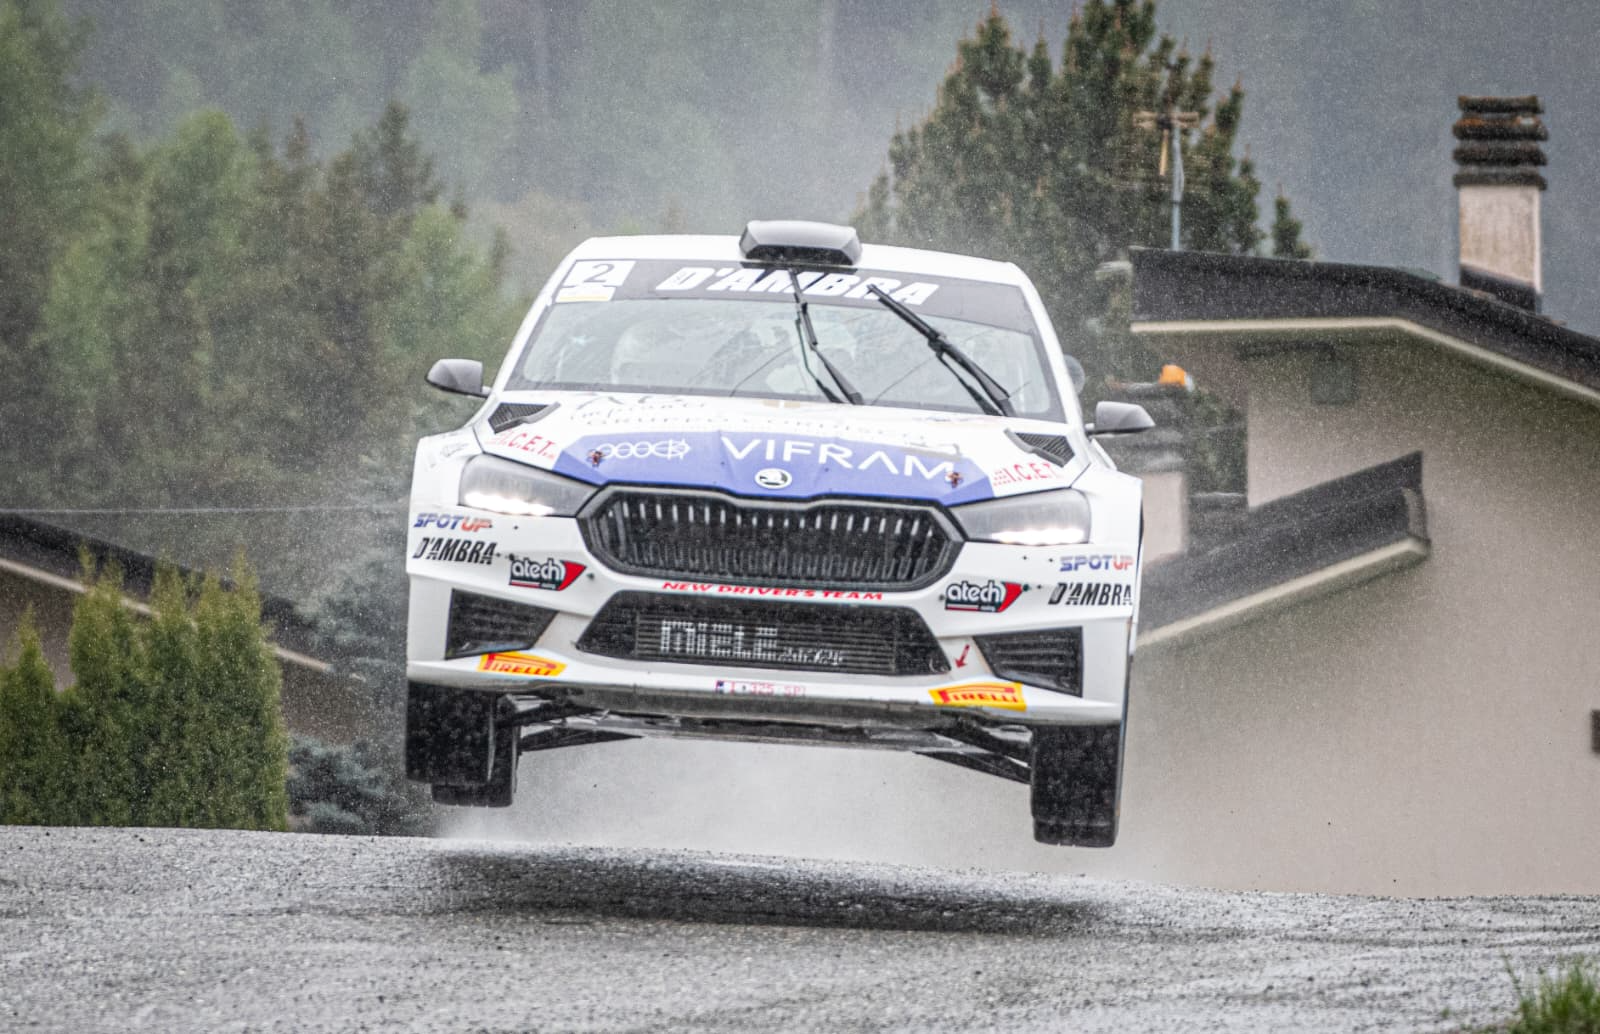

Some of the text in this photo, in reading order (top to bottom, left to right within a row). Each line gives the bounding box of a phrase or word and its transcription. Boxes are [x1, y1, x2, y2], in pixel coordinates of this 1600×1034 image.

[583, 263, 615, 283] 2
[655, 266, 940, 306] D'AMBRA
[722, 435, 952, 481] VIFRAM
[413, 512, 491, 532] SPOTUP
[412, 536, 497, 565] D'AMBRA
[511, 556, 562, 581] atech
[1059, 555, 1134, 572] SPOTUP
[661, 581, 712, 592] NEW
[821, 590, 884, 601] TEAM
[945, 579, 1002, 603] atech
[1048, 582, 1133, 606] D'AMBRA
[485, 653, 556, 675] PIRELLI
[937, 685, 1016, 703] PIRELLI
